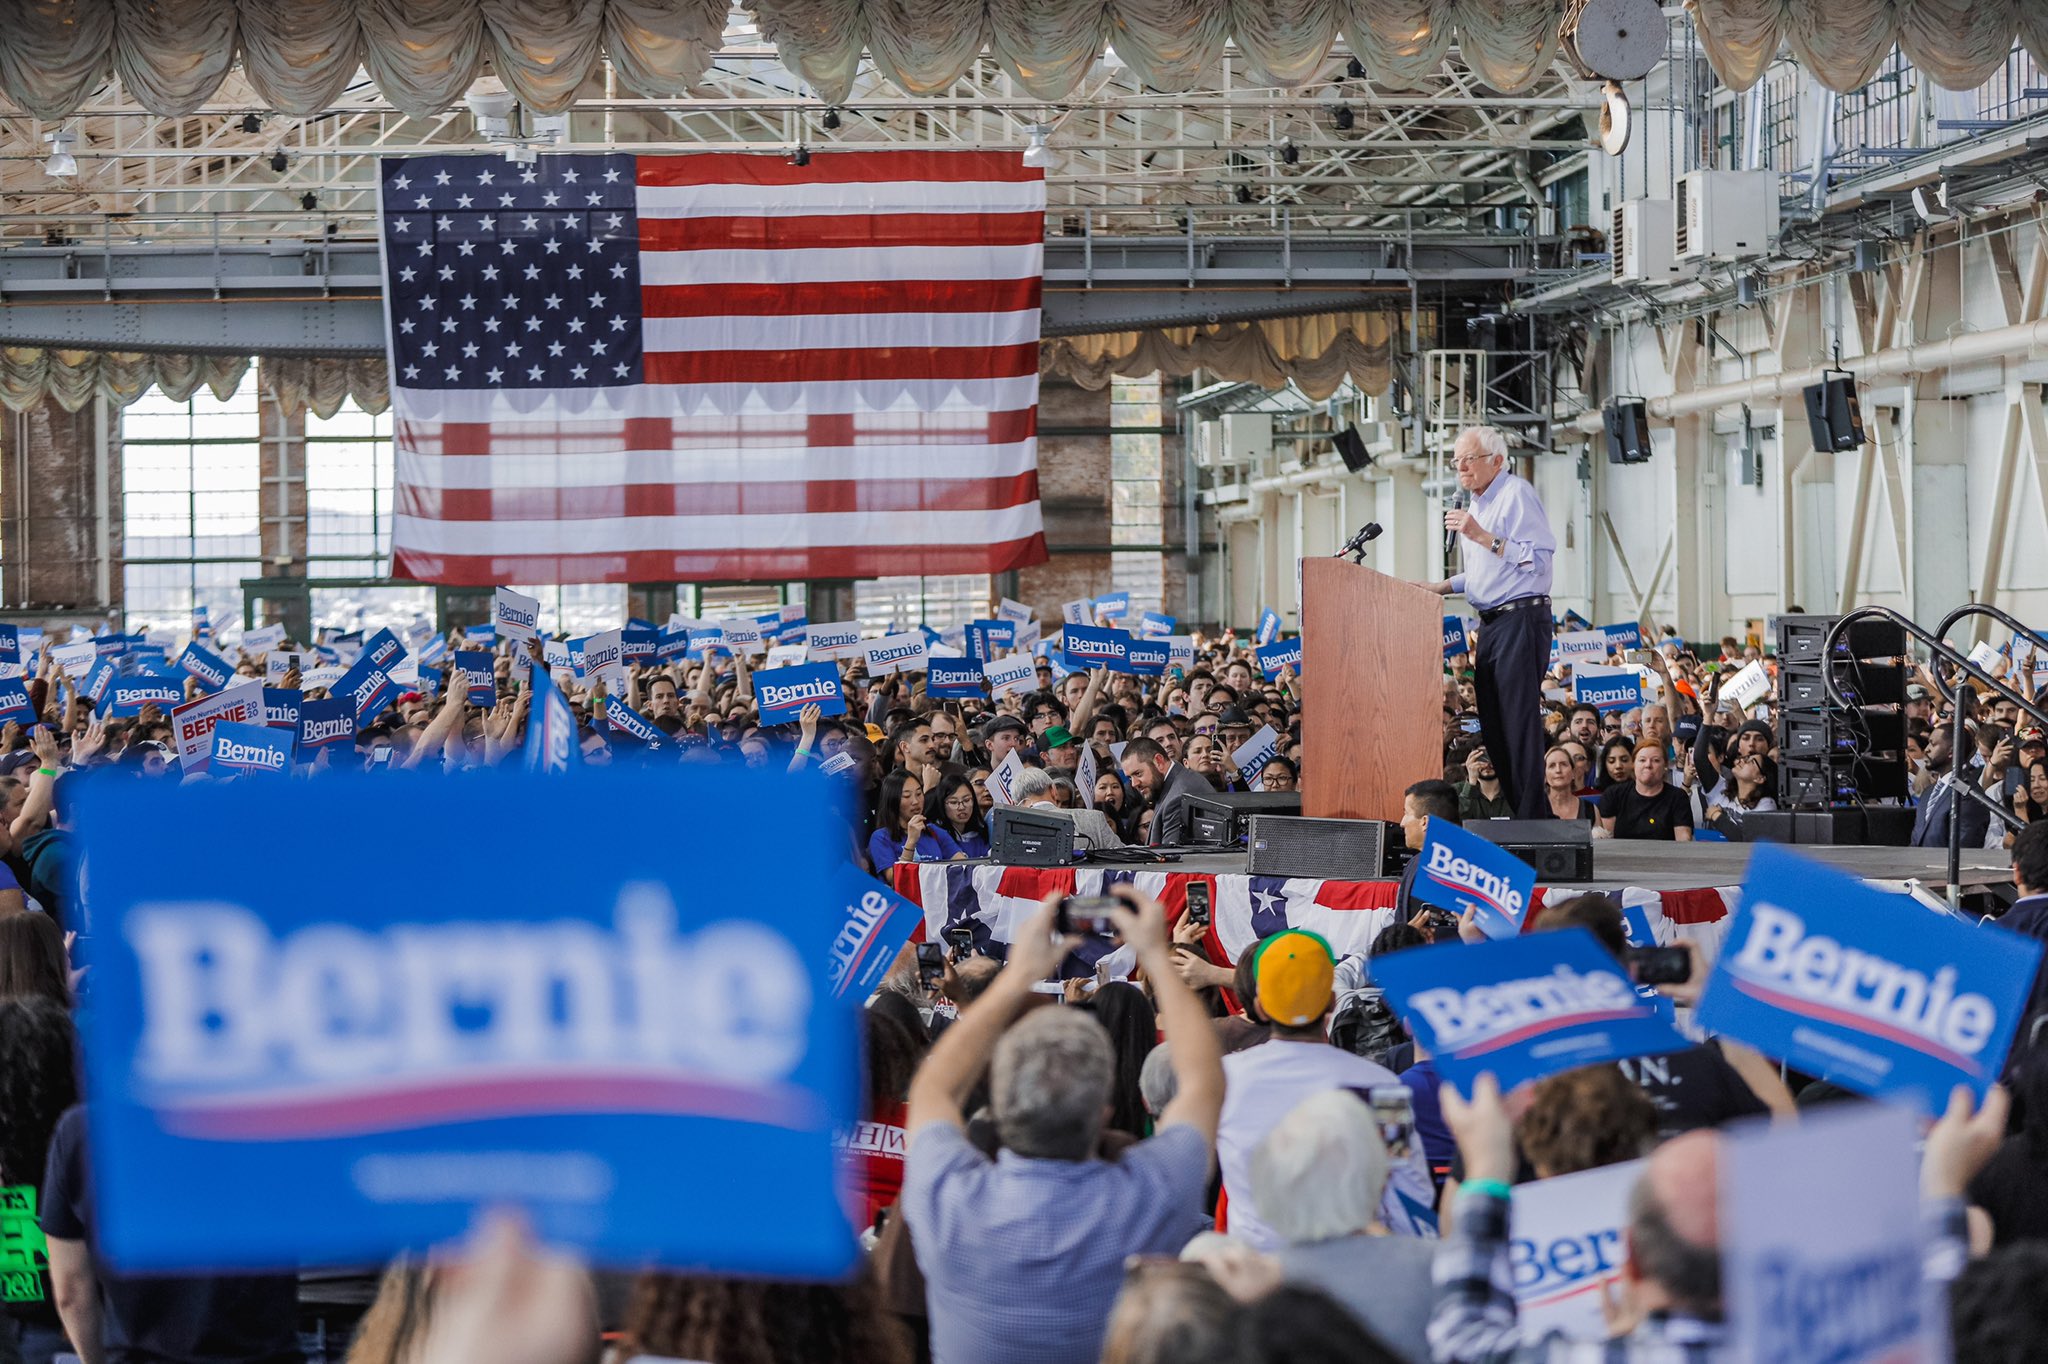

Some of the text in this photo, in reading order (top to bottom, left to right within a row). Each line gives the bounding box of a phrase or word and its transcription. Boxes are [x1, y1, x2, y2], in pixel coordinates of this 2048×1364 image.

[499, 601, 534, 627] Bernie
[657, 638, 687, 653] ernie
[724, 629, 758, 642] Bernie
[810, 632, 858, 647] Bernie
[1068, 635, 1126, 656] Bernie
[1443, 630, 1462, 645] nie
[1607, 629, 1637, 642] ernie
[370, 639, 398, 664] rnie
[620, 640, 656, 653] Bernie
[868, 643, 923, 662] Bernie
[1129, 649, 1166, 664] ernie
[1170, 645, 1191, 657] nie
[1562, 641, 1603, 653] Bernie
[183, 651, 226, 686] Bernie
[585, 645, 619, 671] Bernie
[1261, 648, 1302, 669] Bernie
[89, 664, 113, 699] ernie
[931, 668, 983, 682] Bernie
[987, 666, 1032, 686] Bernie
[115, 687, 181, 702] Bernie
[353, 670, 386, 703] ernie
[761, 677, 837, 704] Bernie
[1581, 685, 1637, 704] Bernie
[0, 691, 28, 711] nie
[181, 714, 197, 724] Vote
[222, 698, 244, 710] Values
[246, 701, 258, 711] 20
[182, 705, 247, 741] BERNIE
[247, 709, 259, 719] 20
[265, 703, 299, 722] rnie
[302, 713, 353, 740] Bernie
[216, 737, 285, 768] Bernie
[1242, 741, 1277, 779] ernie
[1426, 841, 1523, 917] Bernie
[828, 890, 889, 981] ernie
[125, 881, 812, 1082] Bernie
[1733, 901, 1997, 1055] Bernie
[1406, 963, 1636, 1047] Bernie
[1510, 1226, 1621, 1287] Ber
